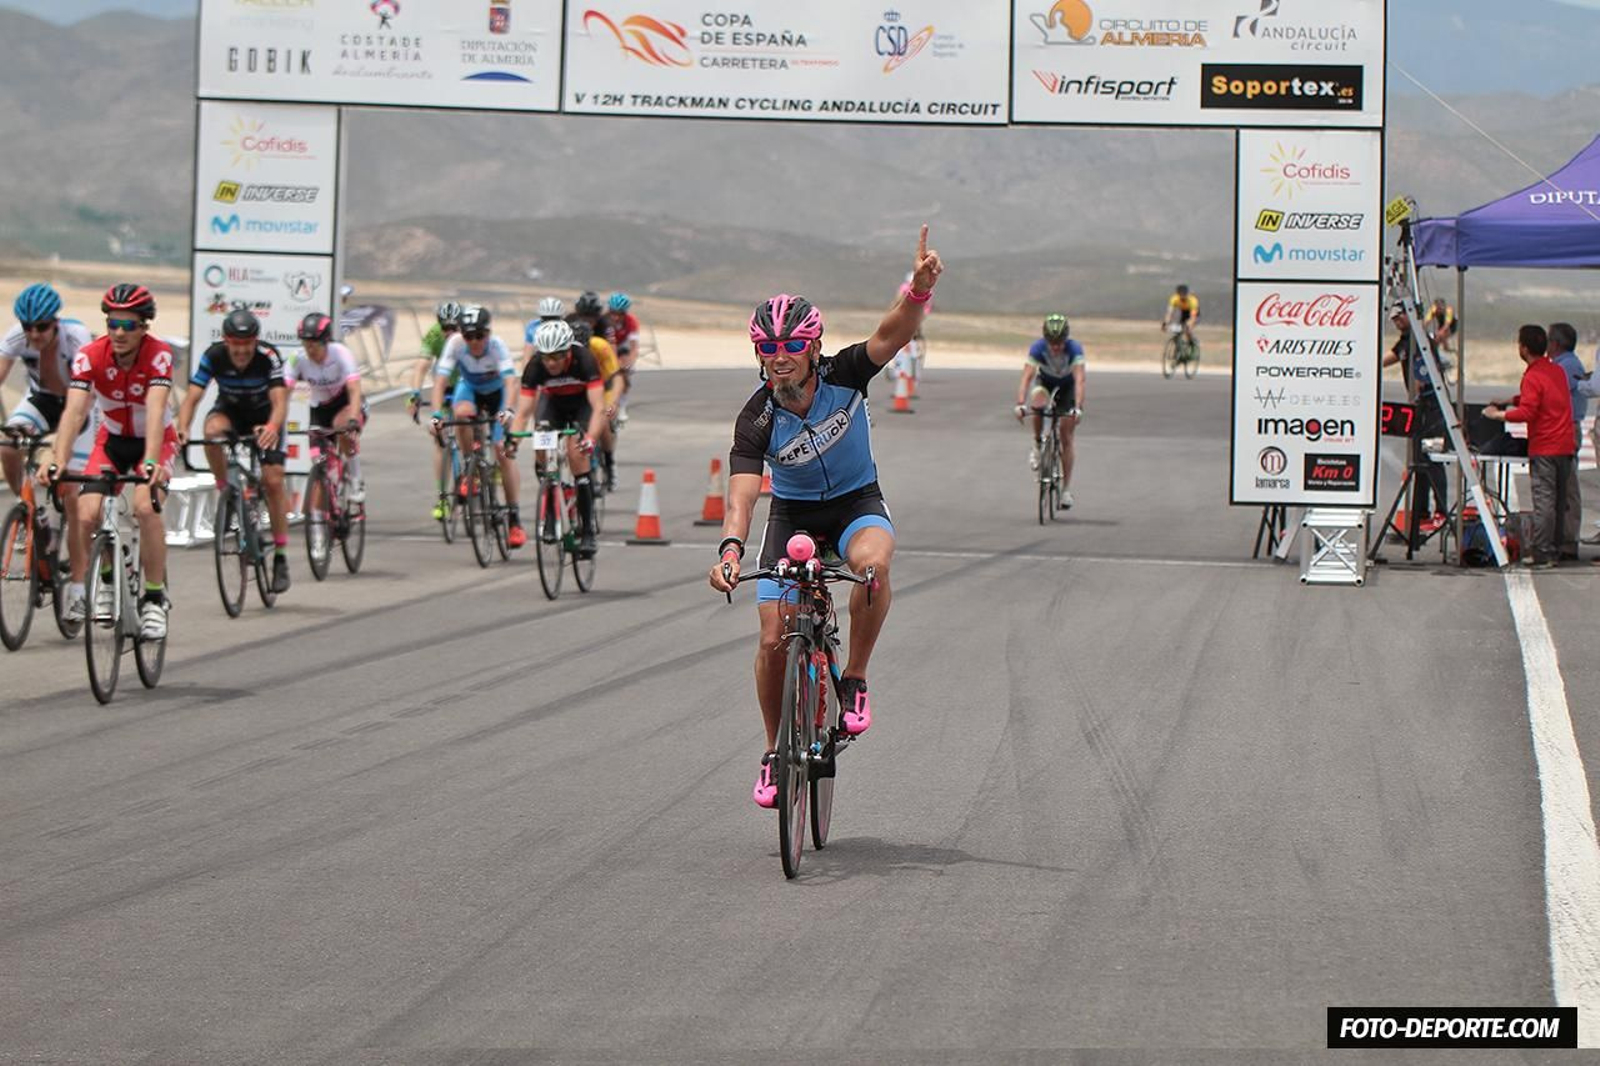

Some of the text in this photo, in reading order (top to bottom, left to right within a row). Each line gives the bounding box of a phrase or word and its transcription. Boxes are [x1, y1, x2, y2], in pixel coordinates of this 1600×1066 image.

[701, 13, 752, 27] COPA
[1100, 19, 1208, 32] CIRCUITO DE
[700, 30, 808, 47] DE ESPAÑA
[875, 25, 908, 56] CSD
[1261, 25, 1358, 40] ANDALUCÍA
[1290, 40, 1348, 51] circuit
[228, 48, 312, 74] GOBIK
[700, 56, 790, 70] CARRETERA
[1058, 75, 1178, 100] infisport
[574, 93, 1001, 116] V 12H TRACKMAN CYCLING ANDALUCÍA CIRCUIT
[241, 136, 309, 152] Cofidis
[1283, 162, 1351, 179] Cofidis
[243, 185, 319, 203] INVERSE
[245, 219, 319, 233] movistar
[1285, 212, 1365, 230] INVERSE
[1288, 248, 1365, 262] movistar
[1268, 339, 1356, 356] ARISTIDES
[1256, 366, 1355, 379] POWERADE
[1257, 418, 1355, 442] imagen
[1312, 466, 1339, 479] Km
